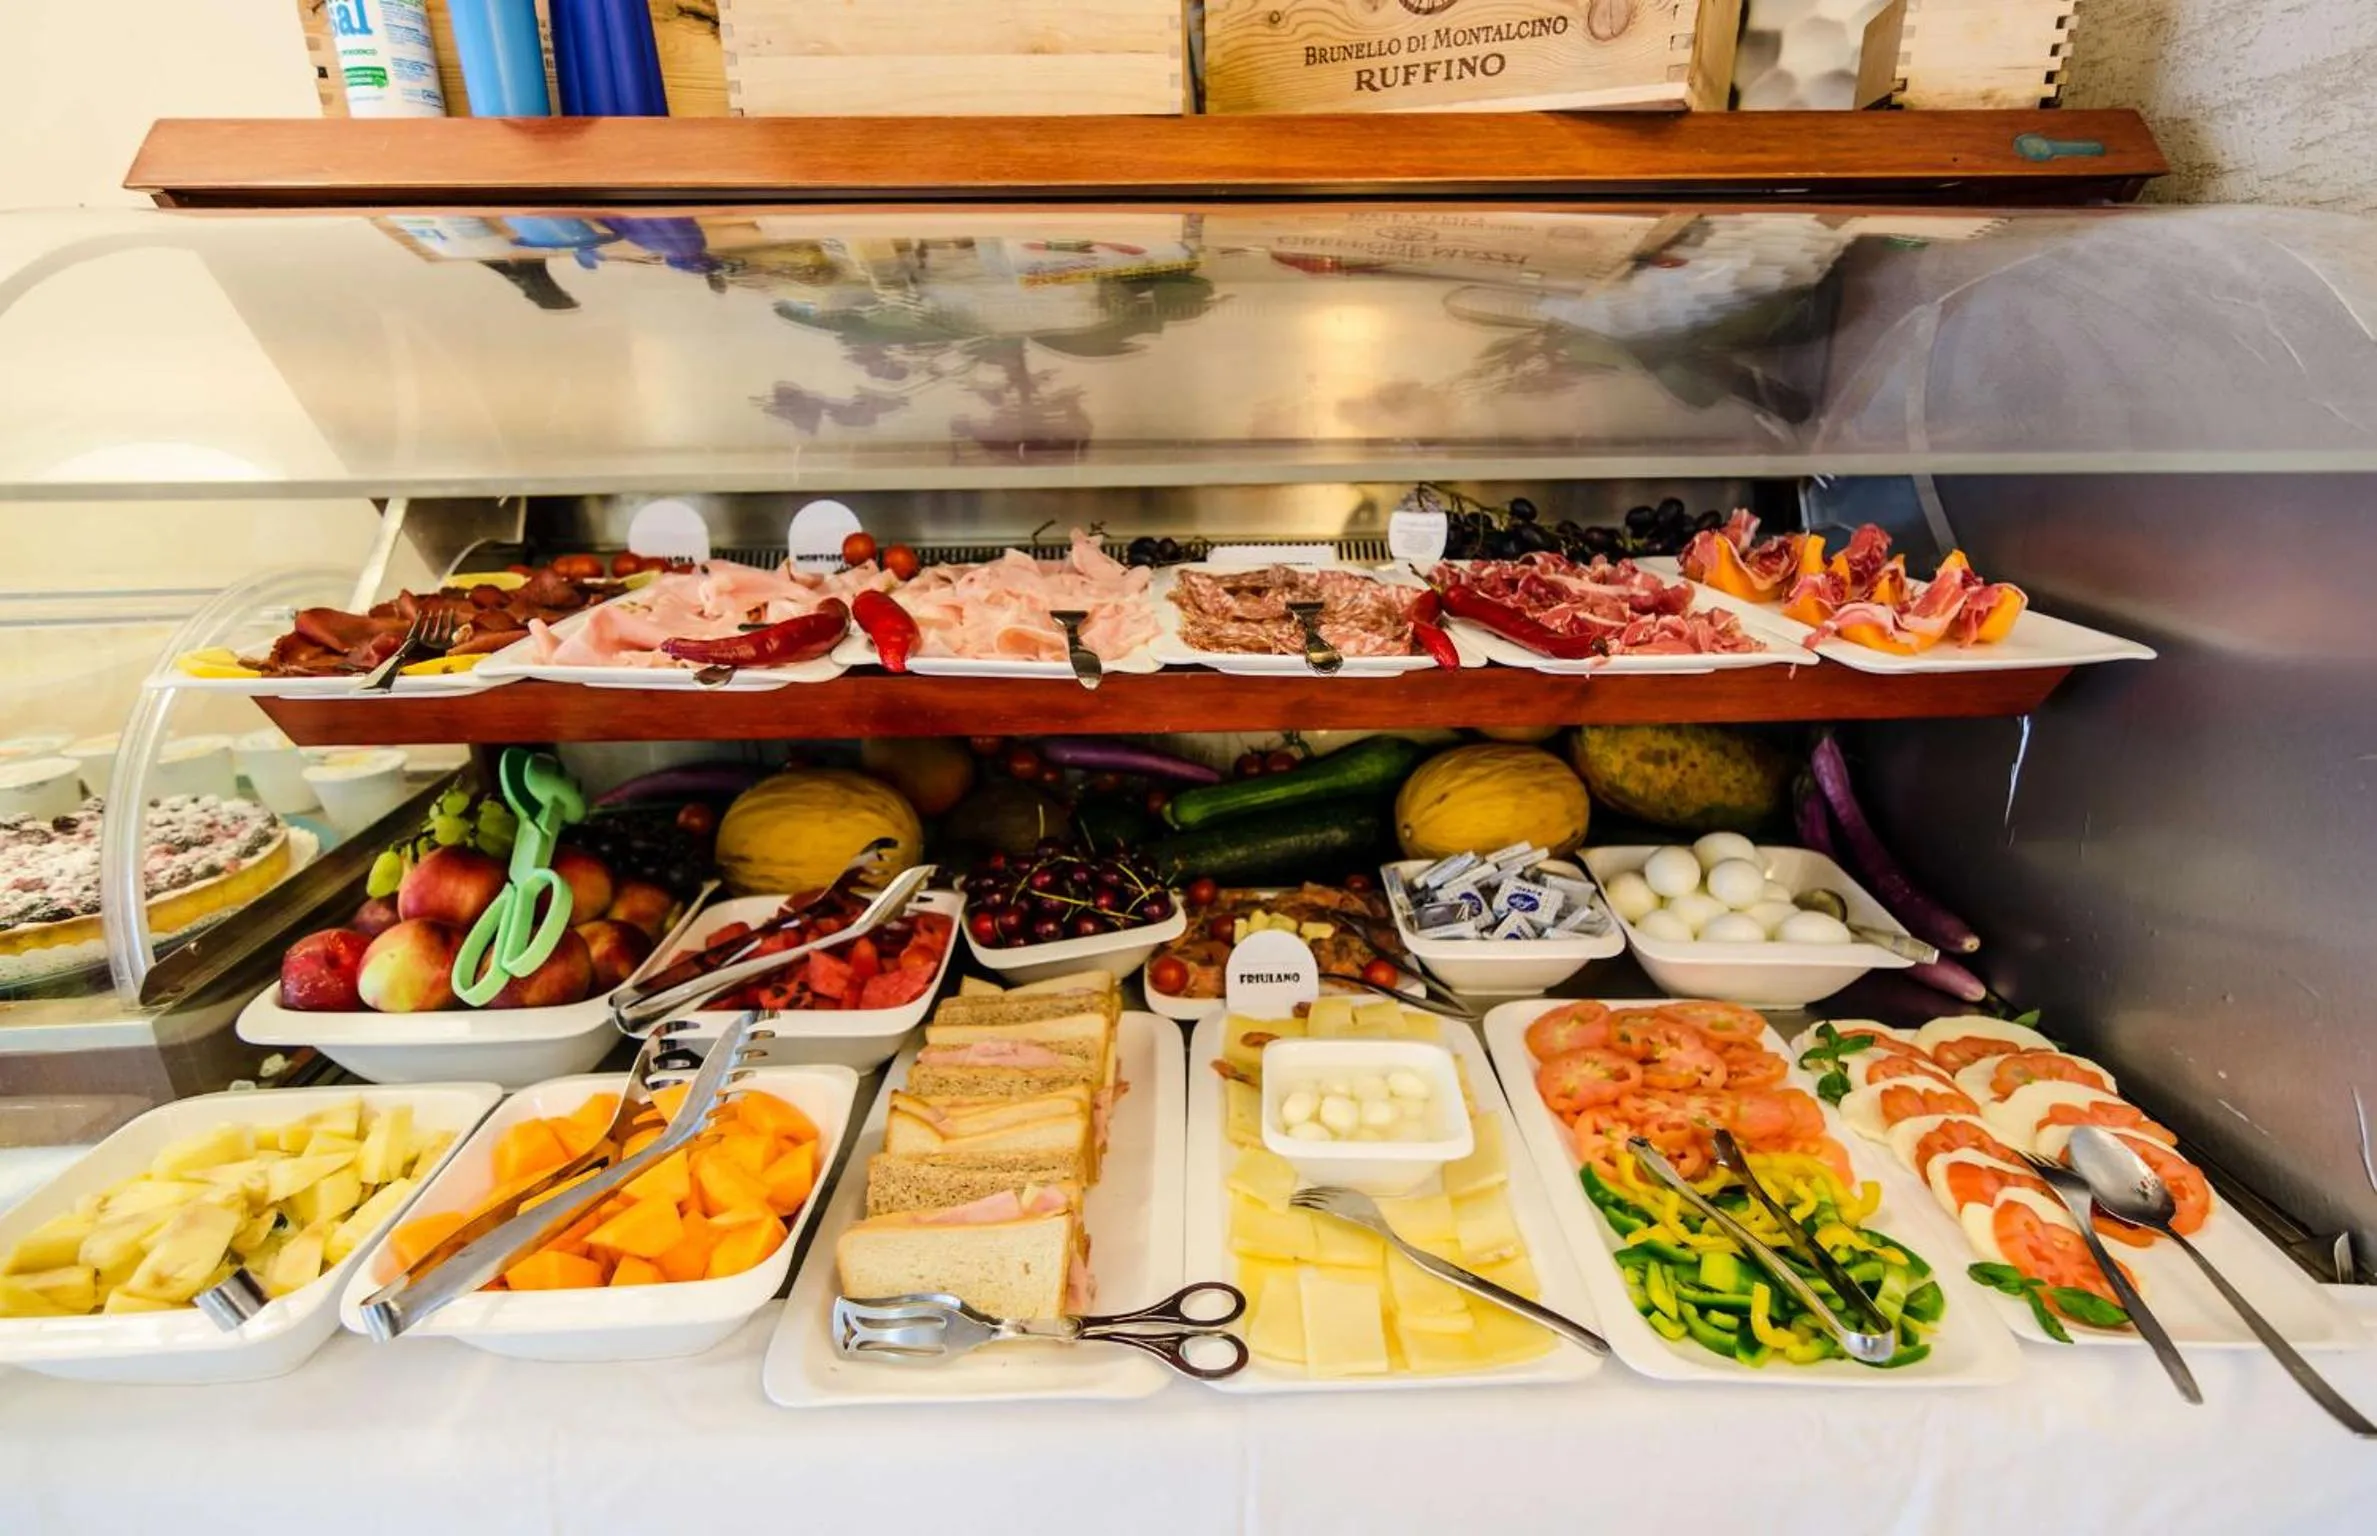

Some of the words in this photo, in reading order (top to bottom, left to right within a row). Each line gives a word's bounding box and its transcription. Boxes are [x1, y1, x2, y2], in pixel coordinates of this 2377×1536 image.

[1304, 38, 1401, 67] BRUNELLO
[1407, 34, 1428, 53] DI
[1432, 15, 1568, 50] MONTALCINO
[1354, 53, 1507, 93] RUFFINO
[1239, 972, 1301, 985] FRIULANO
